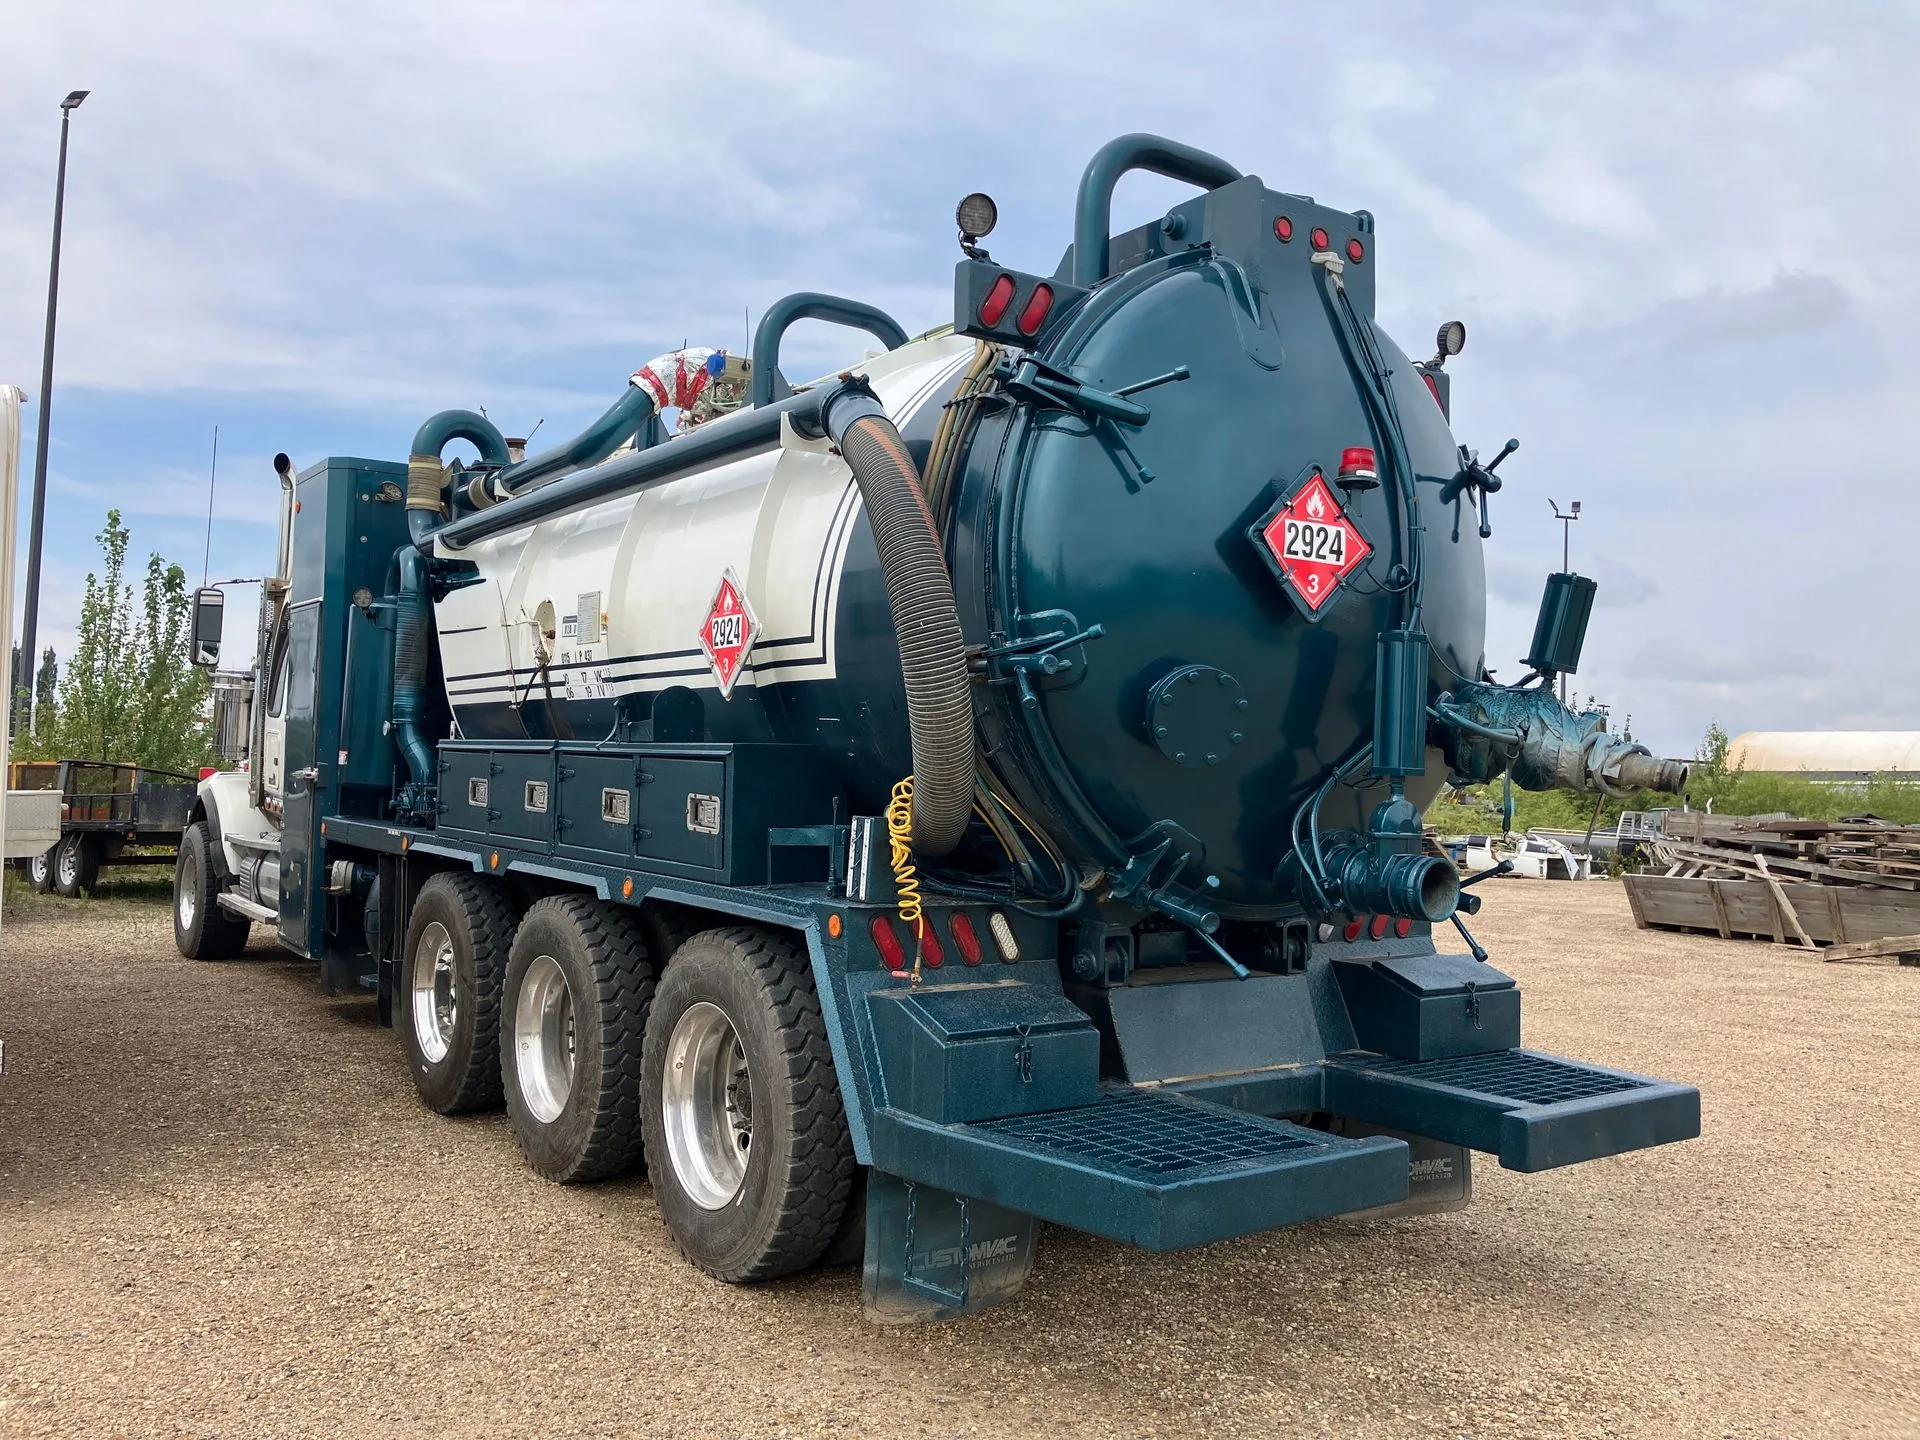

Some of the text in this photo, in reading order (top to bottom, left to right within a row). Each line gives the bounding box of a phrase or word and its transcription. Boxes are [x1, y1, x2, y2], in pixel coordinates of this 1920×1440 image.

[1285, 522, 1343, 562] 2924
[1306, 573, 1319, 594] 3
[712, 616, 741, 647] 2924
[723, 657, 729, 674] 3
